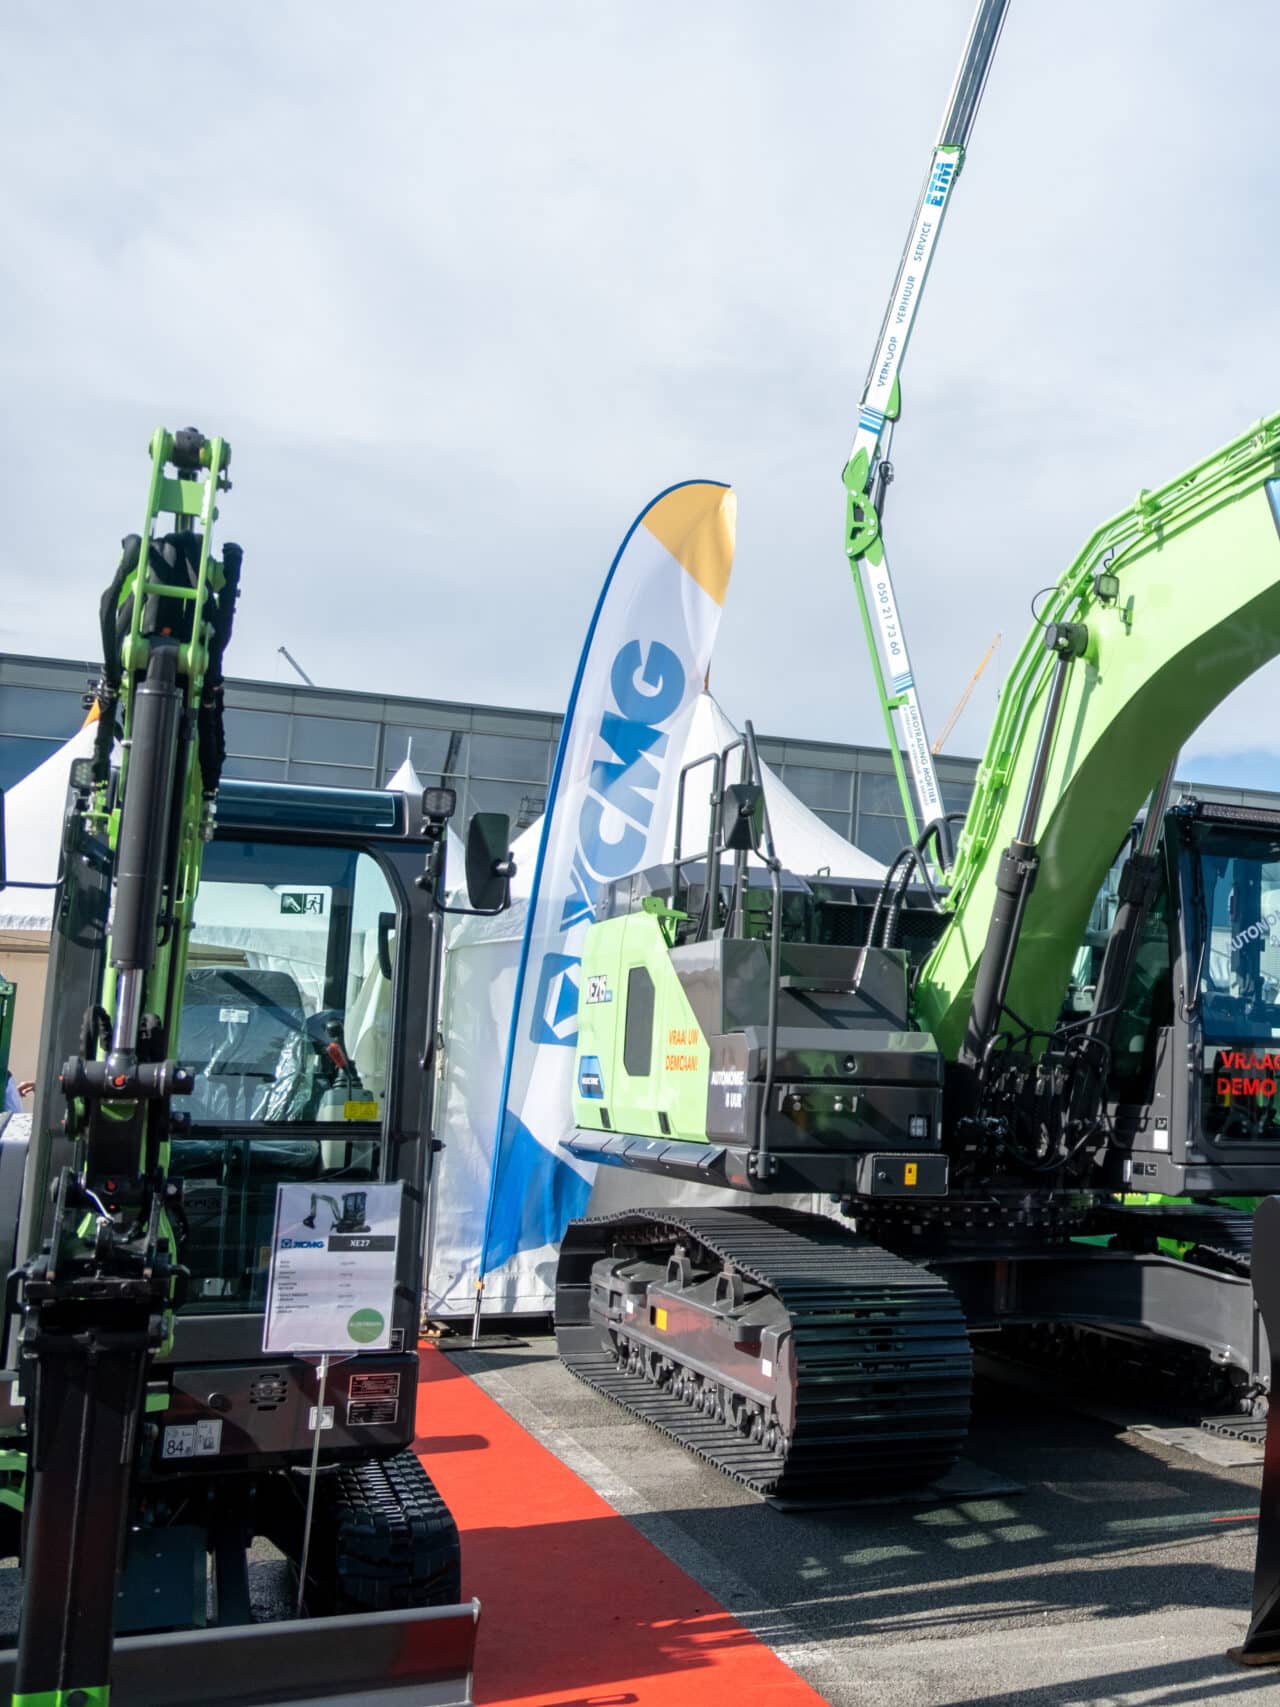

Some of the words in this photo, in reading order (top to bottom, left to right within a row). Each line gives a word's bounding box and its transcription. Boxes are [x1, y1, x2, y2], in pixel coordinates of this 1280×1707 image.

[925, 163, 954, 207] ETM
[877, 336, 898, 387] VERKOOP
[896, 275, 916, 324] VERHUUR
[914, 221, 932, 262] SERVICE
[877, 582, 889, 604] 050
[882, 607, 893, 620] 21
[886, 623, 897, 638] 73
[890, 641, 901, 655] 60
[909, 705, 929, 766] EUROTRADING
[924, 766, 937, 805] MORTIER
[711, 1071, 745, 1086] AUTONOMIE
[1217, 1077, 1276, 1097] DEMO
[350, 1239, 371, 1247] XE27
[167, 1440, 184, 1455] 84
